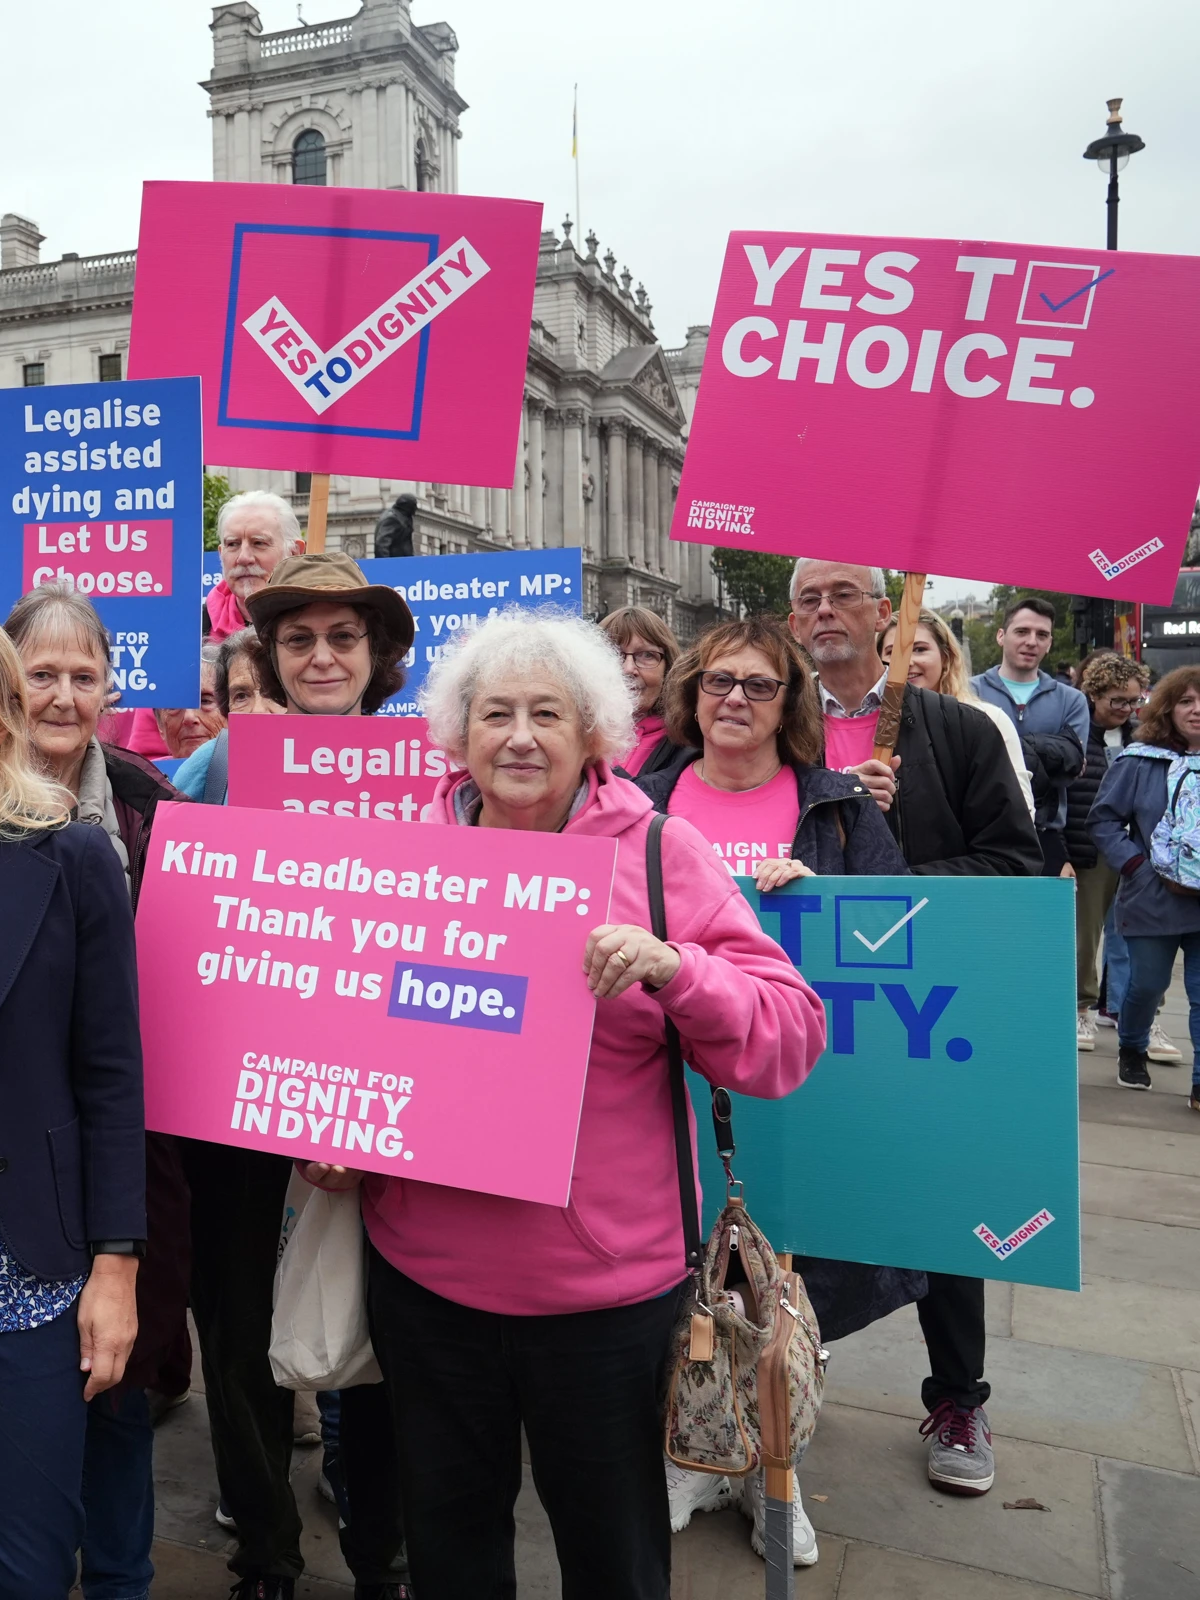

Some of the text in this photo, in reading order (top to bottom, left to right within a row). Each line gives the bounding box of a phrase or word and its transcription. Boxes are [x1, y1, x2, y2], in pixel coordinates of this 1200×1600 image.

[742, 244, 920, 315] YES
[259, 307, 317, 376] YES
[721, 316, 1095, 409] CHOICE.
[24, 398, 161, 437] Legalise
[24, 438, 161, 474] assisted
[12, 479, 175, 520] dying and
[689, 506, 754, 524] DIGNITY
[691, 500, 756, 513] CAMPAIGN FOR
[38, 523, 148, 554] Let Us
[687, 517, 755, 535] IN DYING.
[1093, 551, 1110, 571] YES
[32, 566, 163, 597] Choose.
[396, 573, 572, 602] adbeater MP:
[116, 632, 149, 644] FOR
[110, 669, 157, 690] NG.
[377, 702, 425, 714] CAMPA
[281, 736, 460, 786] Legalis
[161, 839, 591, 916] Kim Leadbeater MP:
[212, 894, 508, 961] Thank you for
[197, 945, 516, 1020] giving us hope.
[242, 1051, 414, 1095] CAMPAIGN FOR
[235, 1068, 412, 1126] DIGNITY
[230, 1101, 414, 1161] IN DYING.
[978, 1226, 1000, 1249] YES
